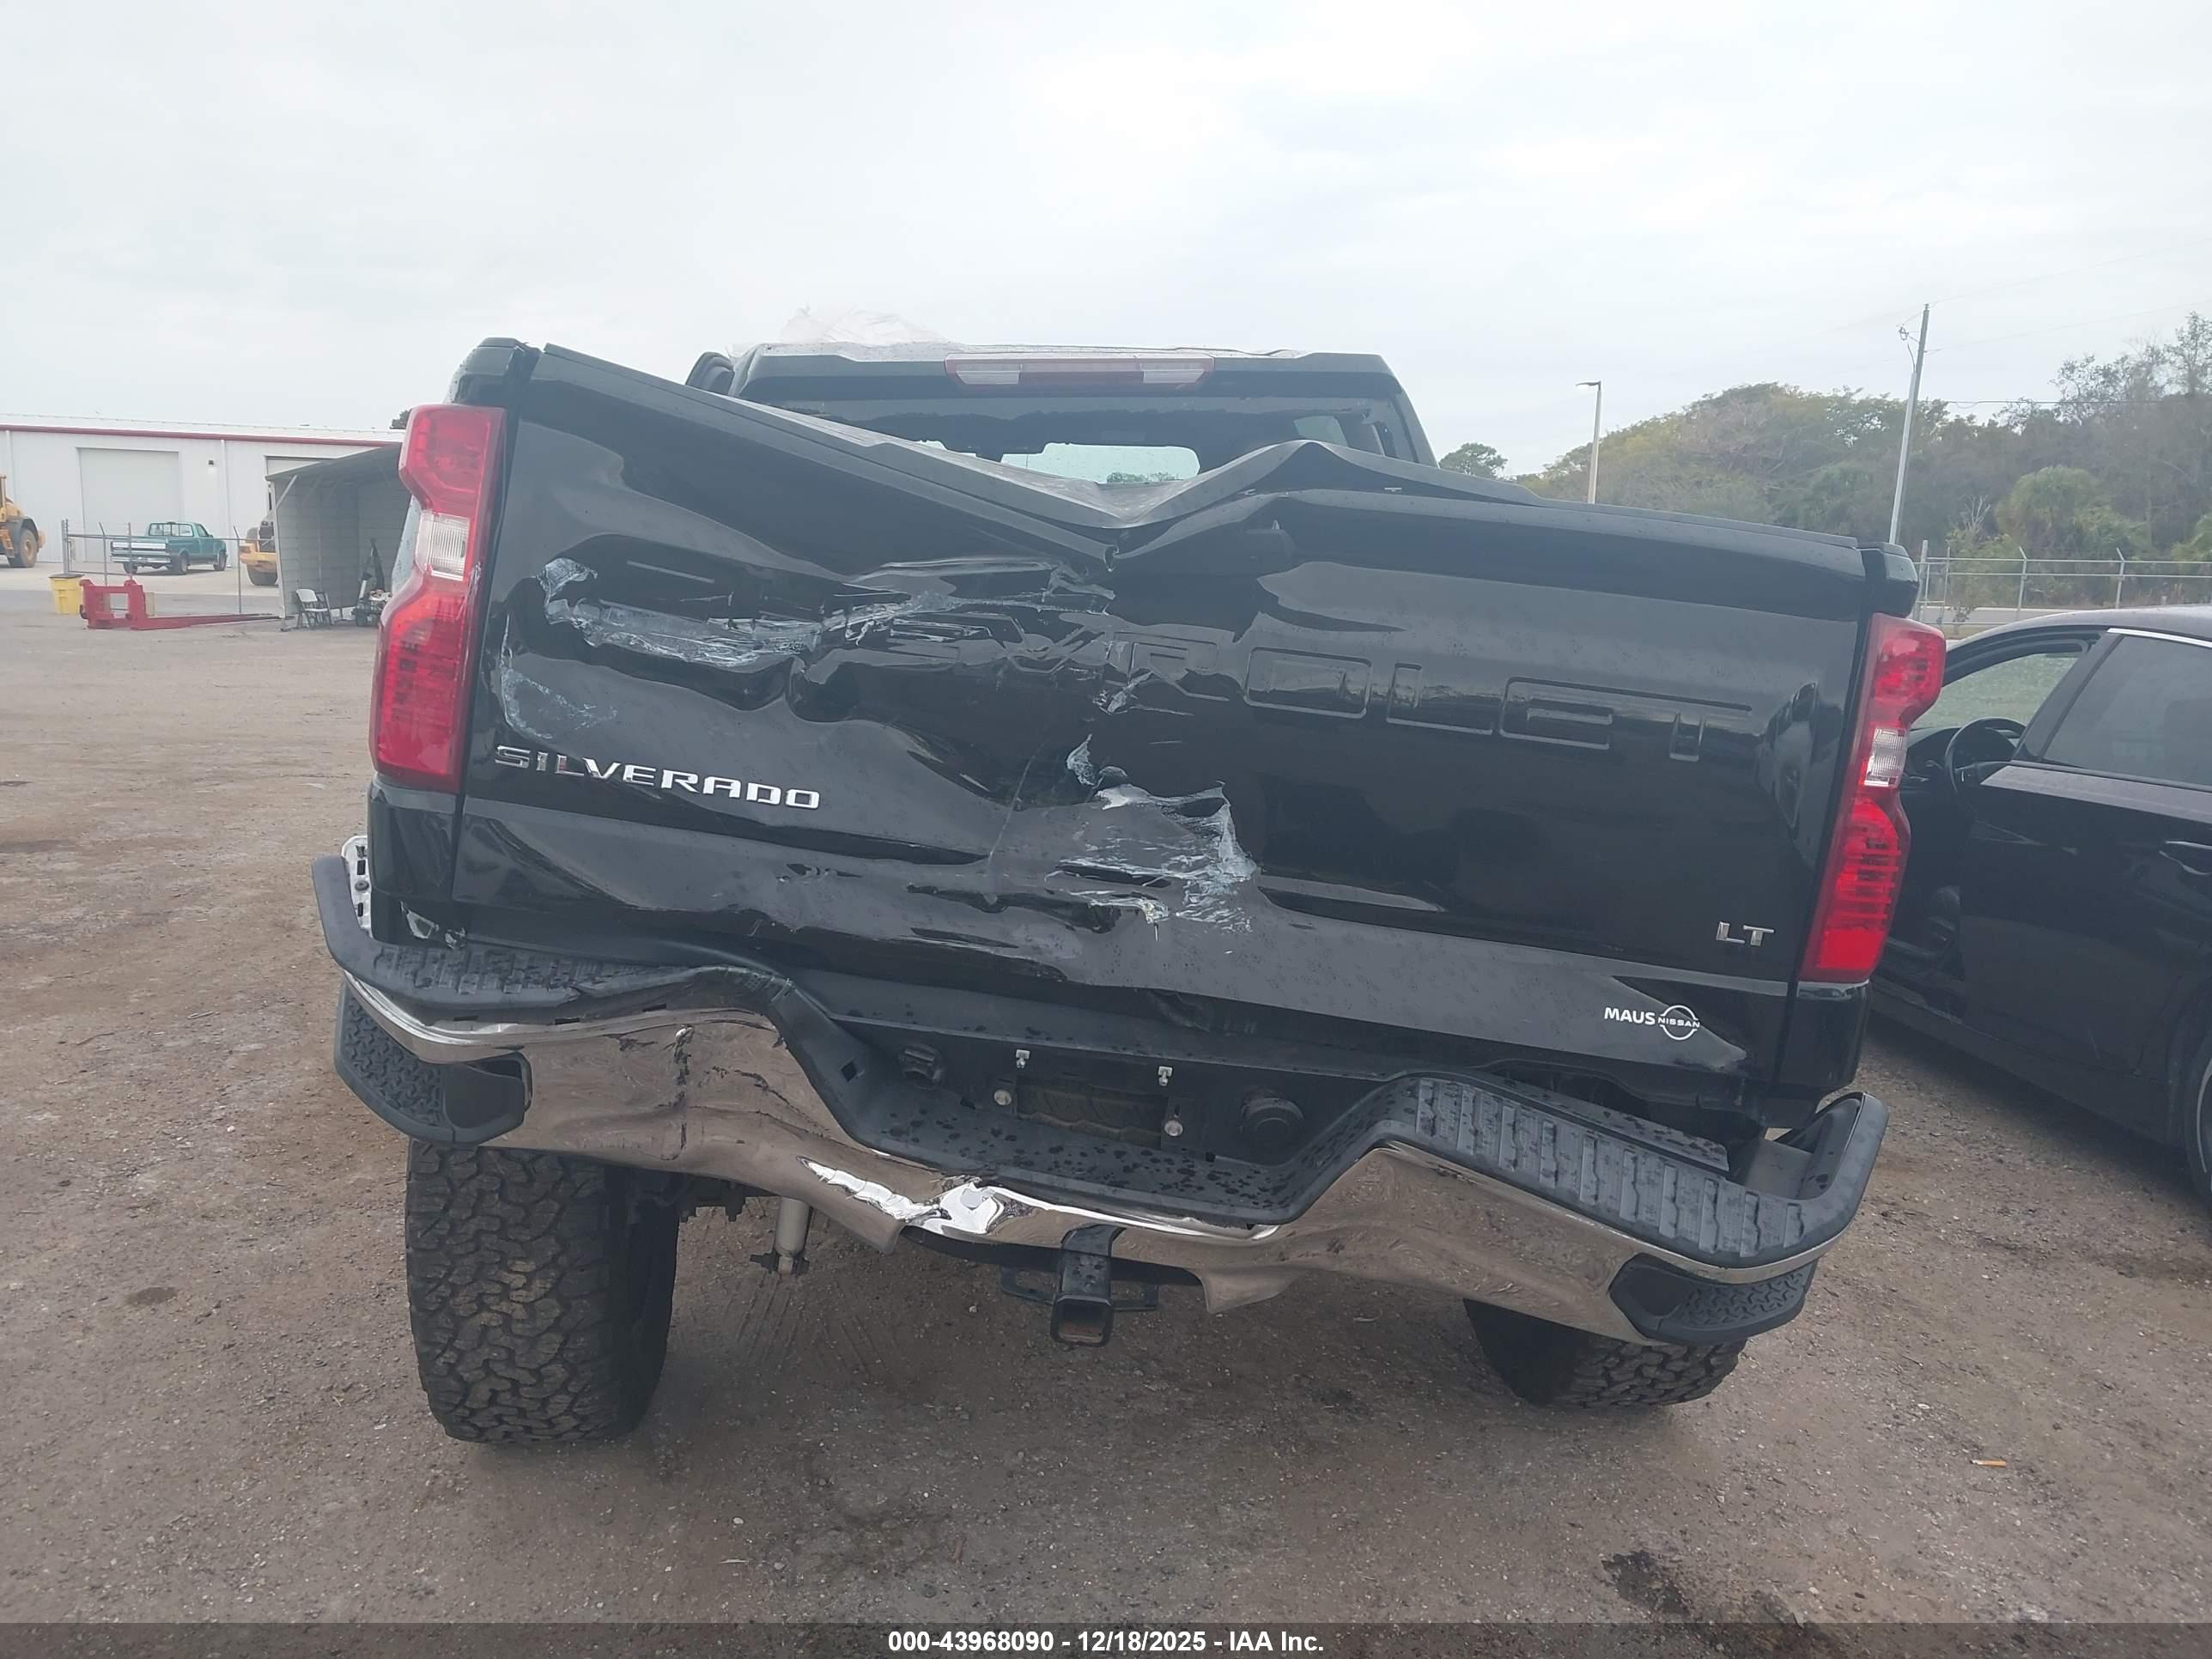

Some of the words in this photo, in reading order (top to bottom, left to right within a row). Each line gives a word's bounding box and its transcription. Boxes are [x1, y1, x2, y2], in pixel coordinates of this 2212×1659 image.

[495, 744, 821, 810] SILVERADO
[1716, 921, 1775, 946] LT
[1603, 1006, 1656, 1025] MAUS
[1657, 1016, 1700, 1028] NISSAN
